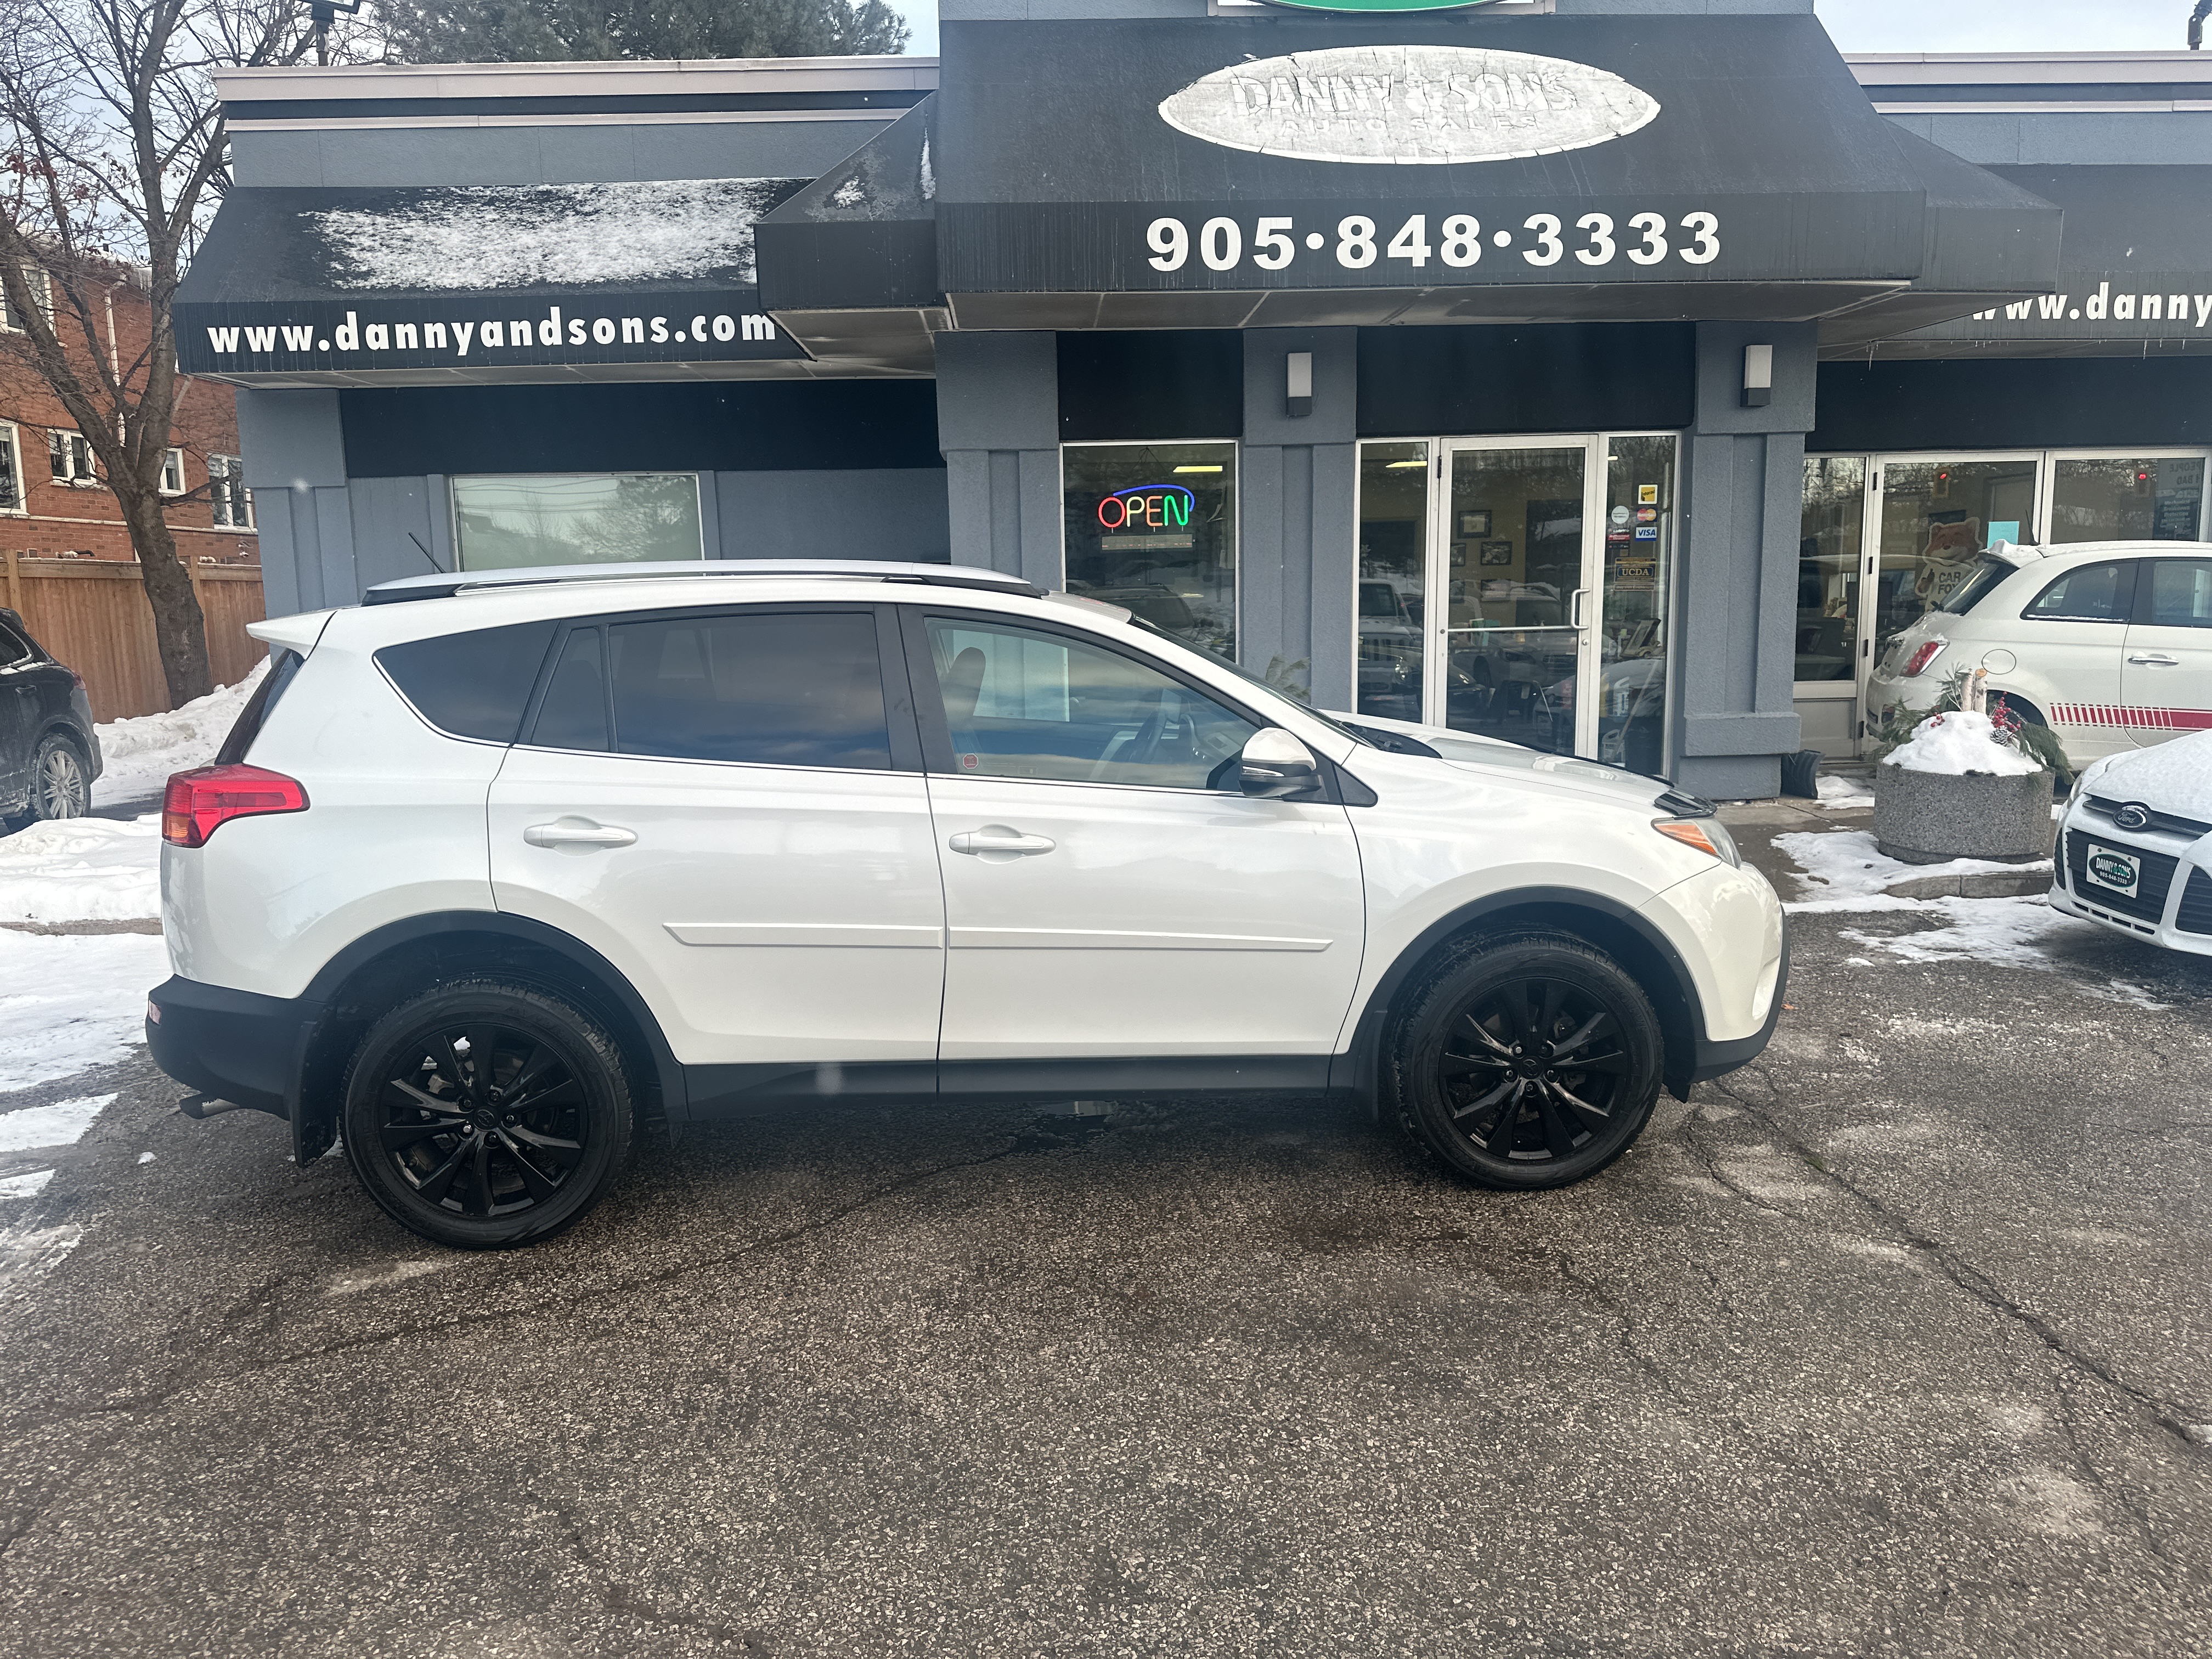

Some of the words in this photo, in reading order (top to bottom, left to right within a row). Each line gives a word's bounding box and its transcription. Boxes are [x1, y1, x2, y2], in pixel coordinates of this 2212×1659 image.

[1231, 74, 1395, 114] DANNY
[1448, 72, 1580, 112] SONS
[1281, 118, 1389, 133] AUTO
[1411, 115, 1539, 131] SALES
[207, 306, 775, 356] www.dannyandsons.com
[1098, 495, 1189, 528] OPEN
[1622, 568, 1650, 576] UCDA
[1939, 571, 1961, 583] CAR
[2118, 811, 2137, 823] Ford
